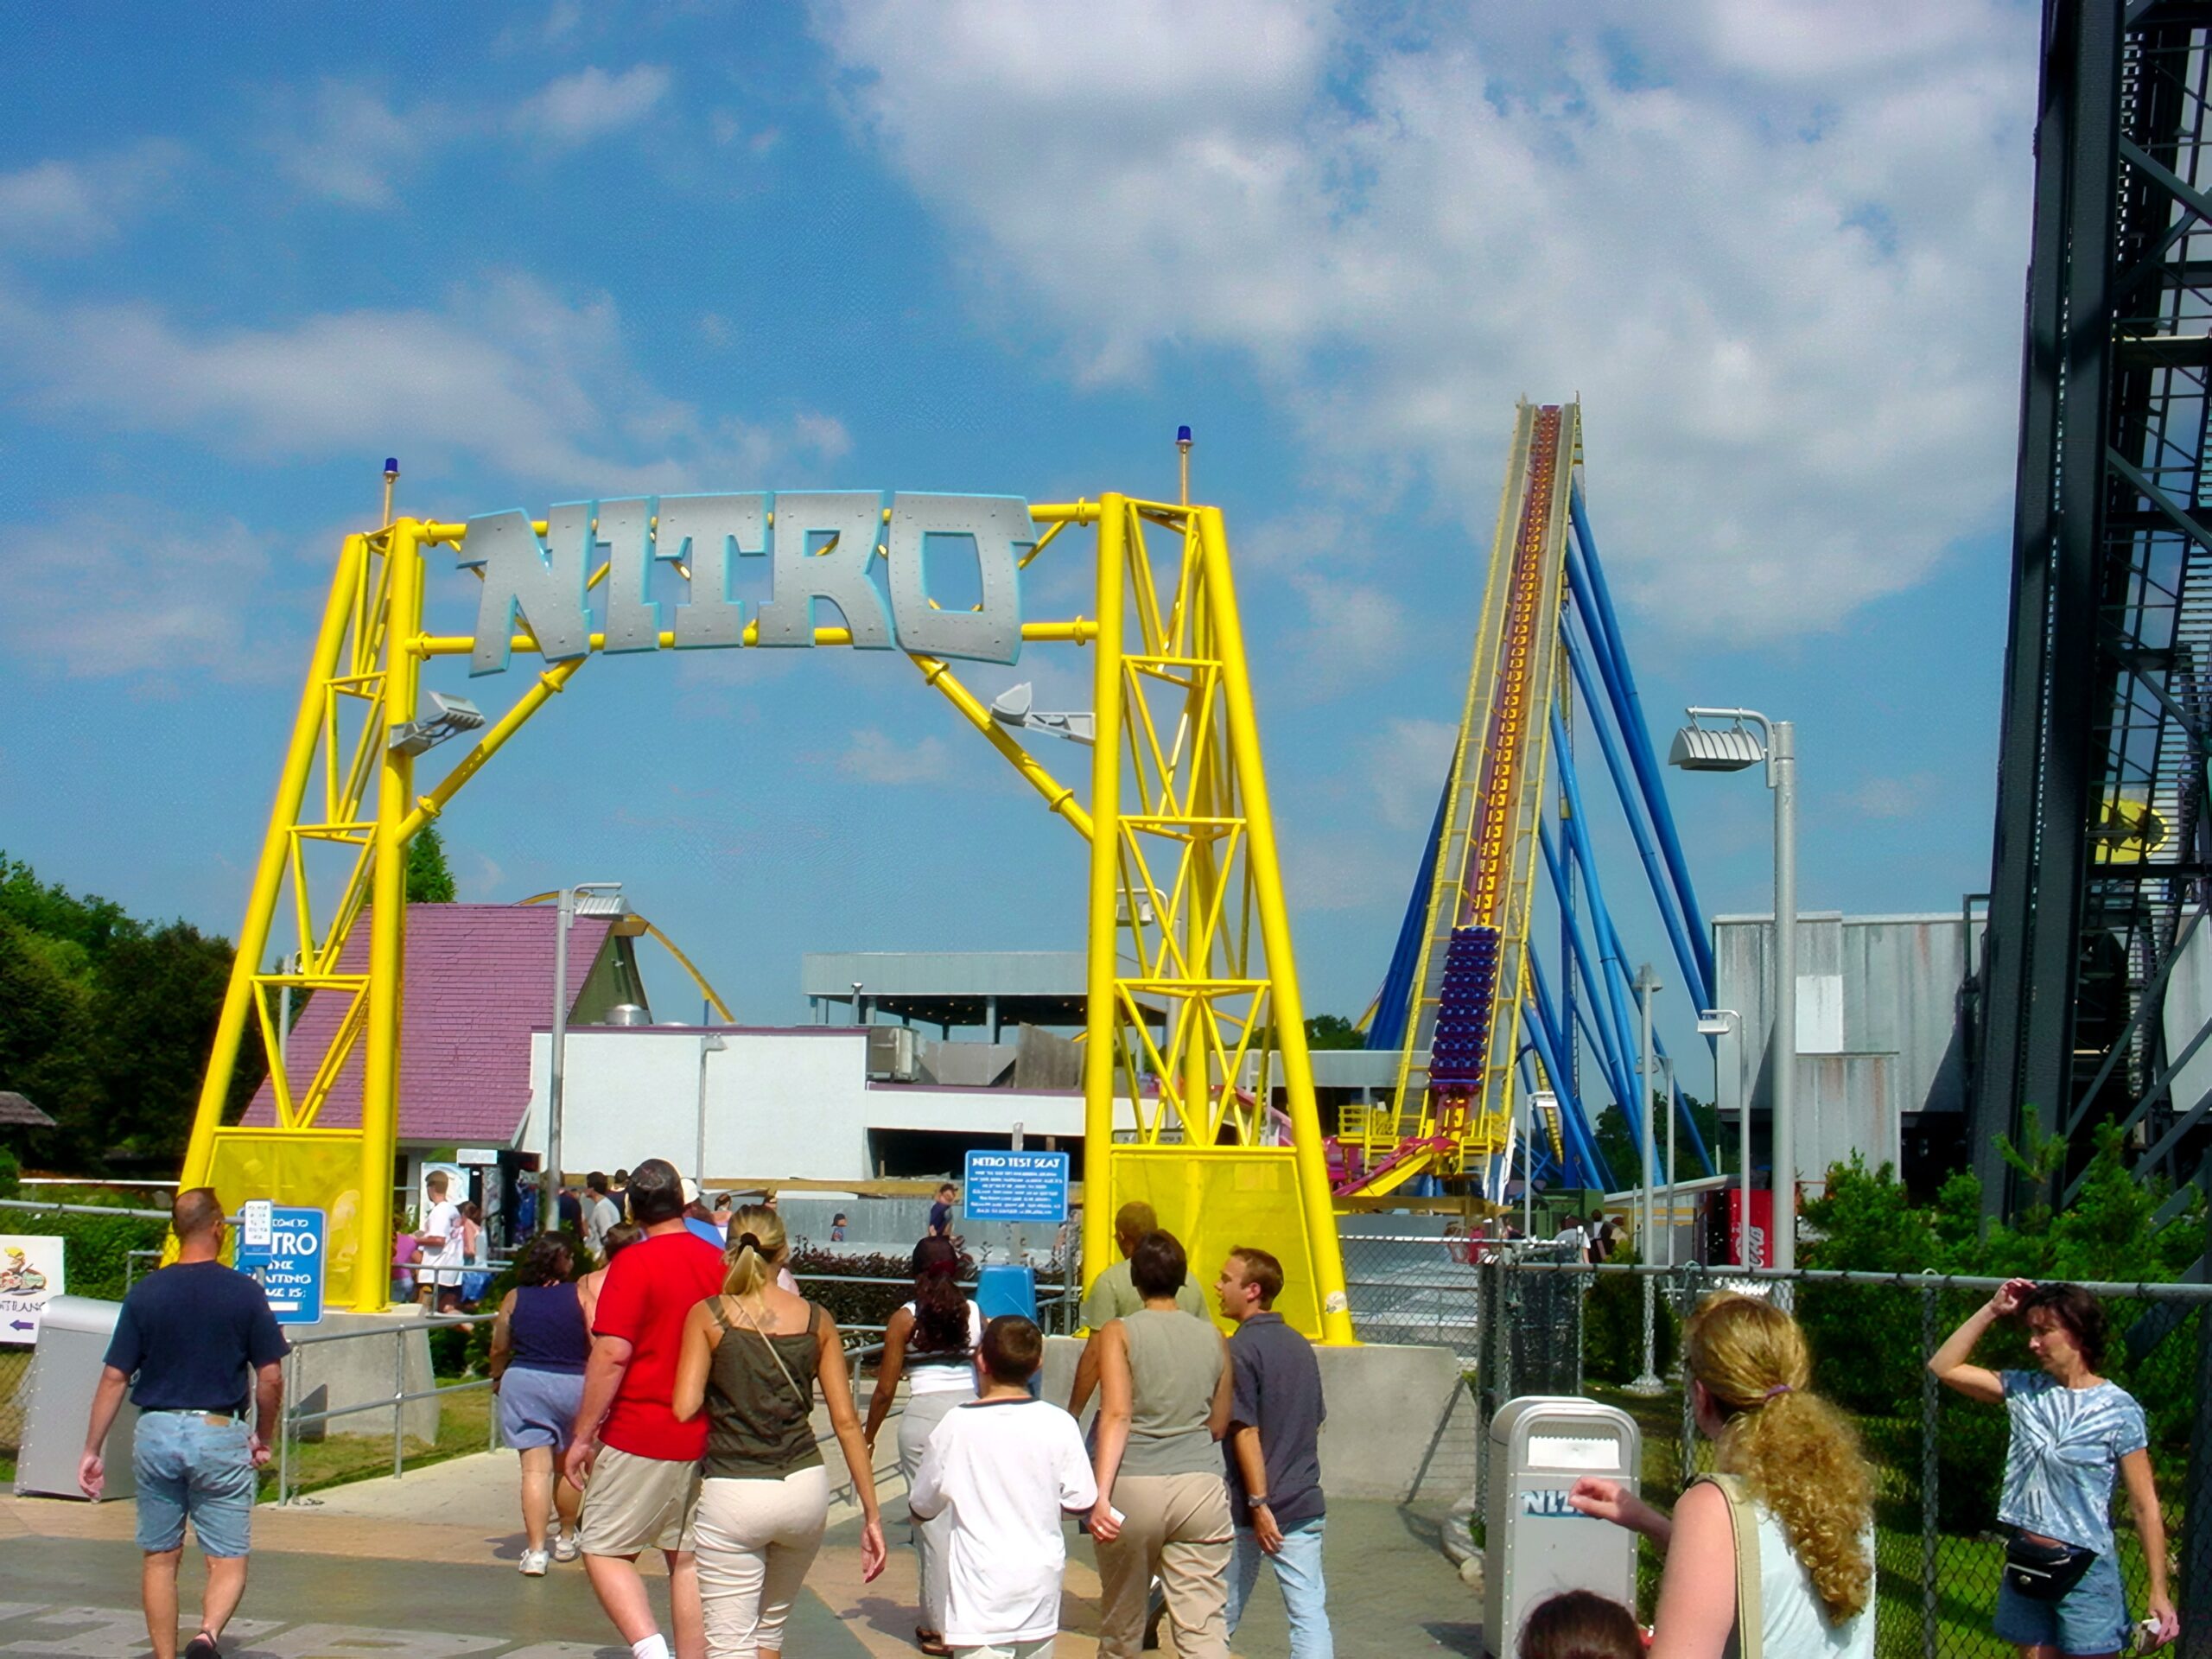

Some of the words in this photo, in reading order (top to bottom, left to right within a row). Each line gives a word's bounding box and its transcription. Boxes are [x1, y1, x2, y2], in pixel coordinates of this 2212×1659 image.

[456, 490, 1038, 678] NITRO
[971, 1157, 1006, 1166] NITRO
[1007, 1157, 1032, 1167] TEST
[1034, 1158, 1061, 1168] SEAT
[271, 1231, 318, 1255] TRO
[1521, 1490, 1580, 1516] NIT
